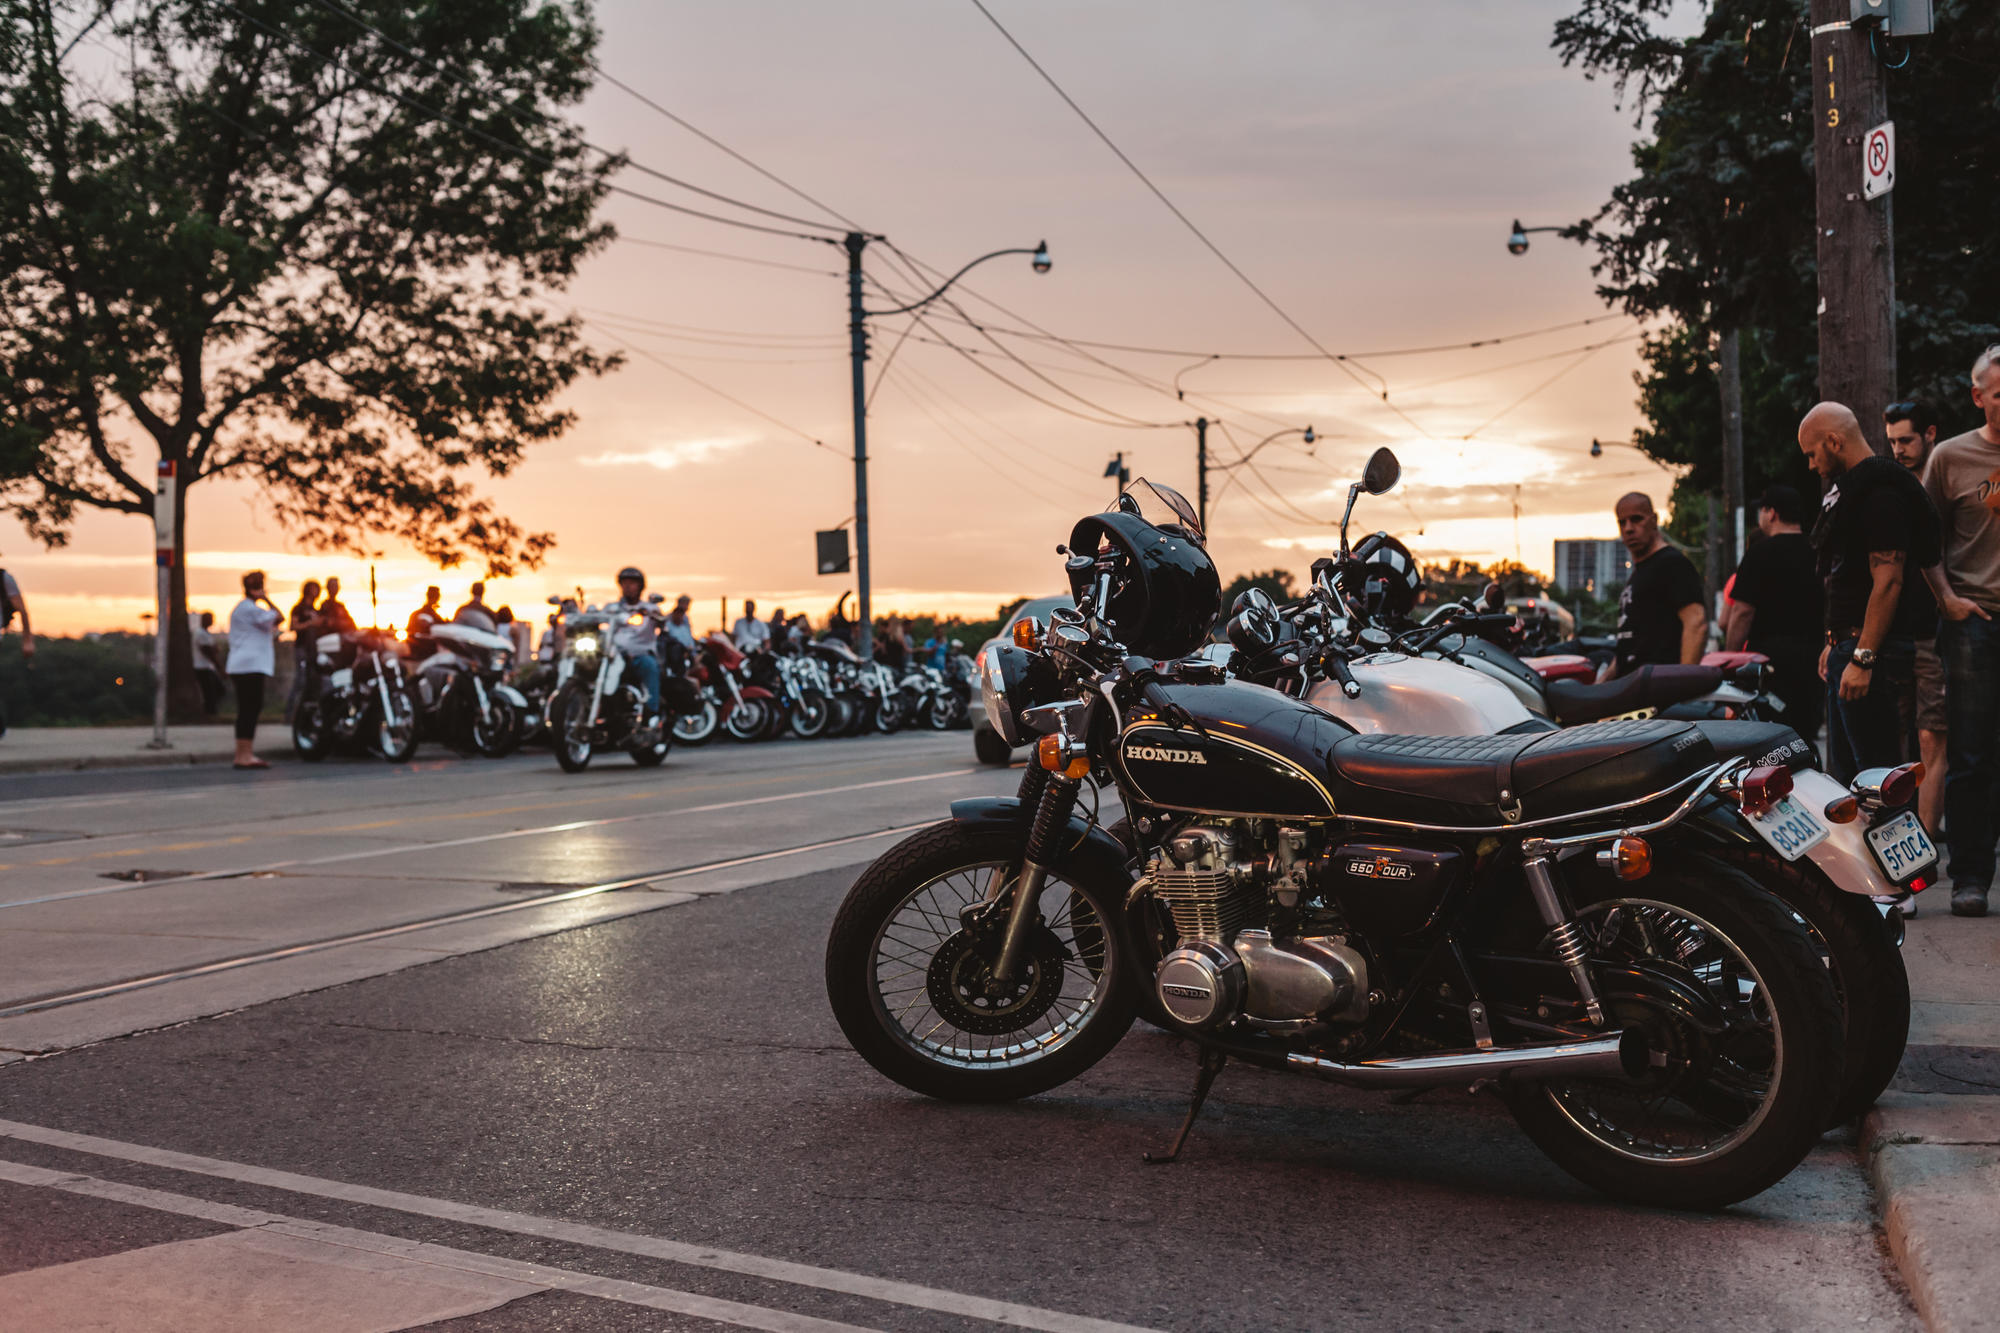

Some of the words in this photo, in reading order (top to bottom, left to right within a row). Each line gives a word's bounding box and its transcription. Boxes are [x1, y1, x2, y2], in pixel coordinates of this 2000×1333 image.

[1827, 55, 1840, 127] 113
[1873, 142, 1884, 167] P
[1126, 745, 1208, 765] HONDA
[1757, 746, 1792, 767] MOTO
[1771, 811, 1820, 851] 8C8A1
[1881, 826, 1897, 841] ONT
[1883, 831, 1931, 871] 5F0C4
[1350, 862, 1374, 874] 550
[1369, 859, 1407, 878] FOUR
[1165, 986, 1209, 998] HONDA
